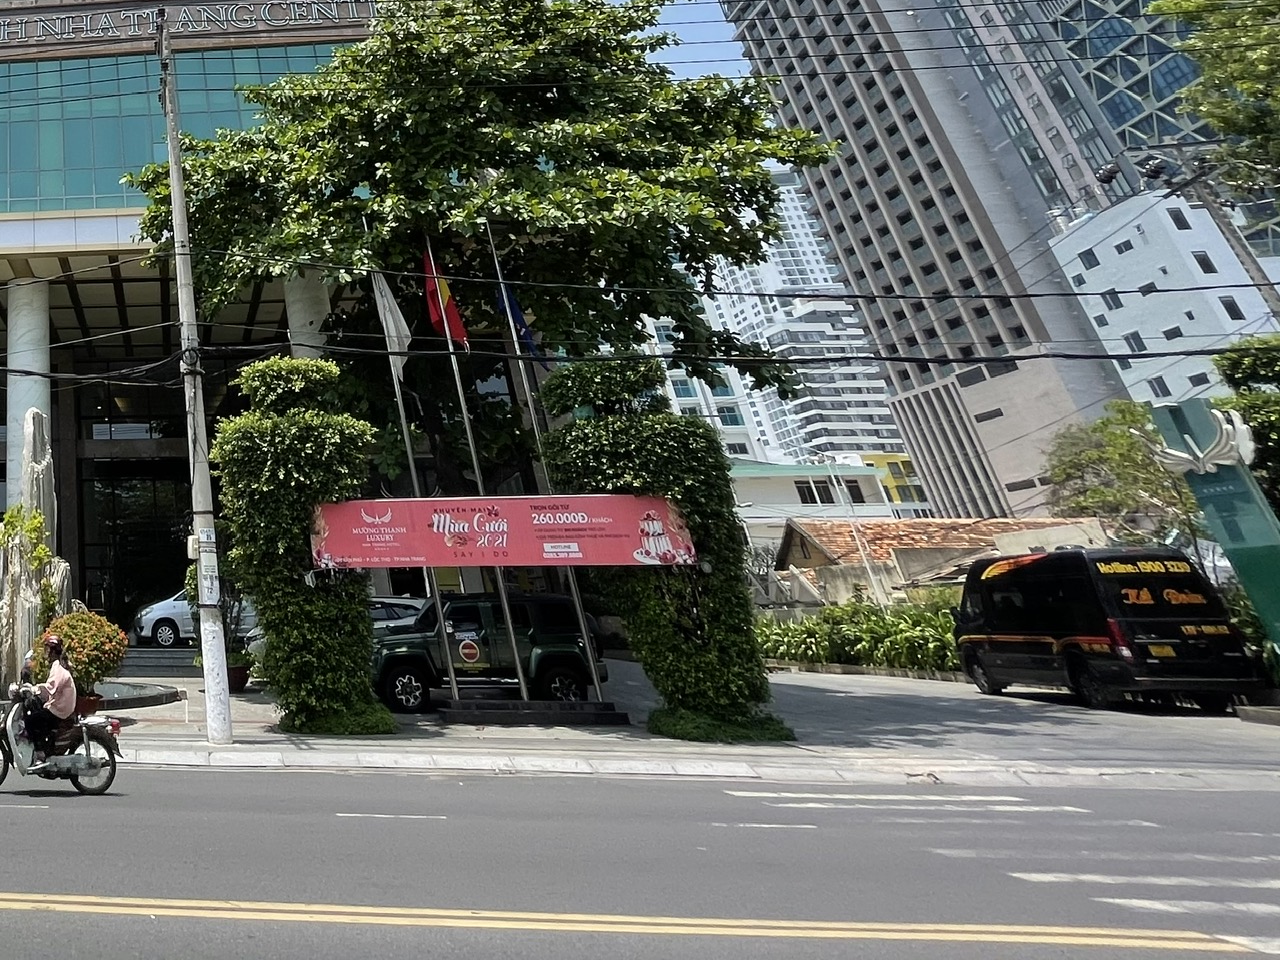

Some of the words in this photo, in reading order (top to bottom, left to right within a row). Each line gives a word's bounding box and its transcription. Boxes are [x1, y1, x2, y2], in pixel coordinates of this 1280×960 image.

[35, 12, 120, 40] NHA
[476, 533, 508, 547] 2021
[1137, 561, 1166, 572] 1900
